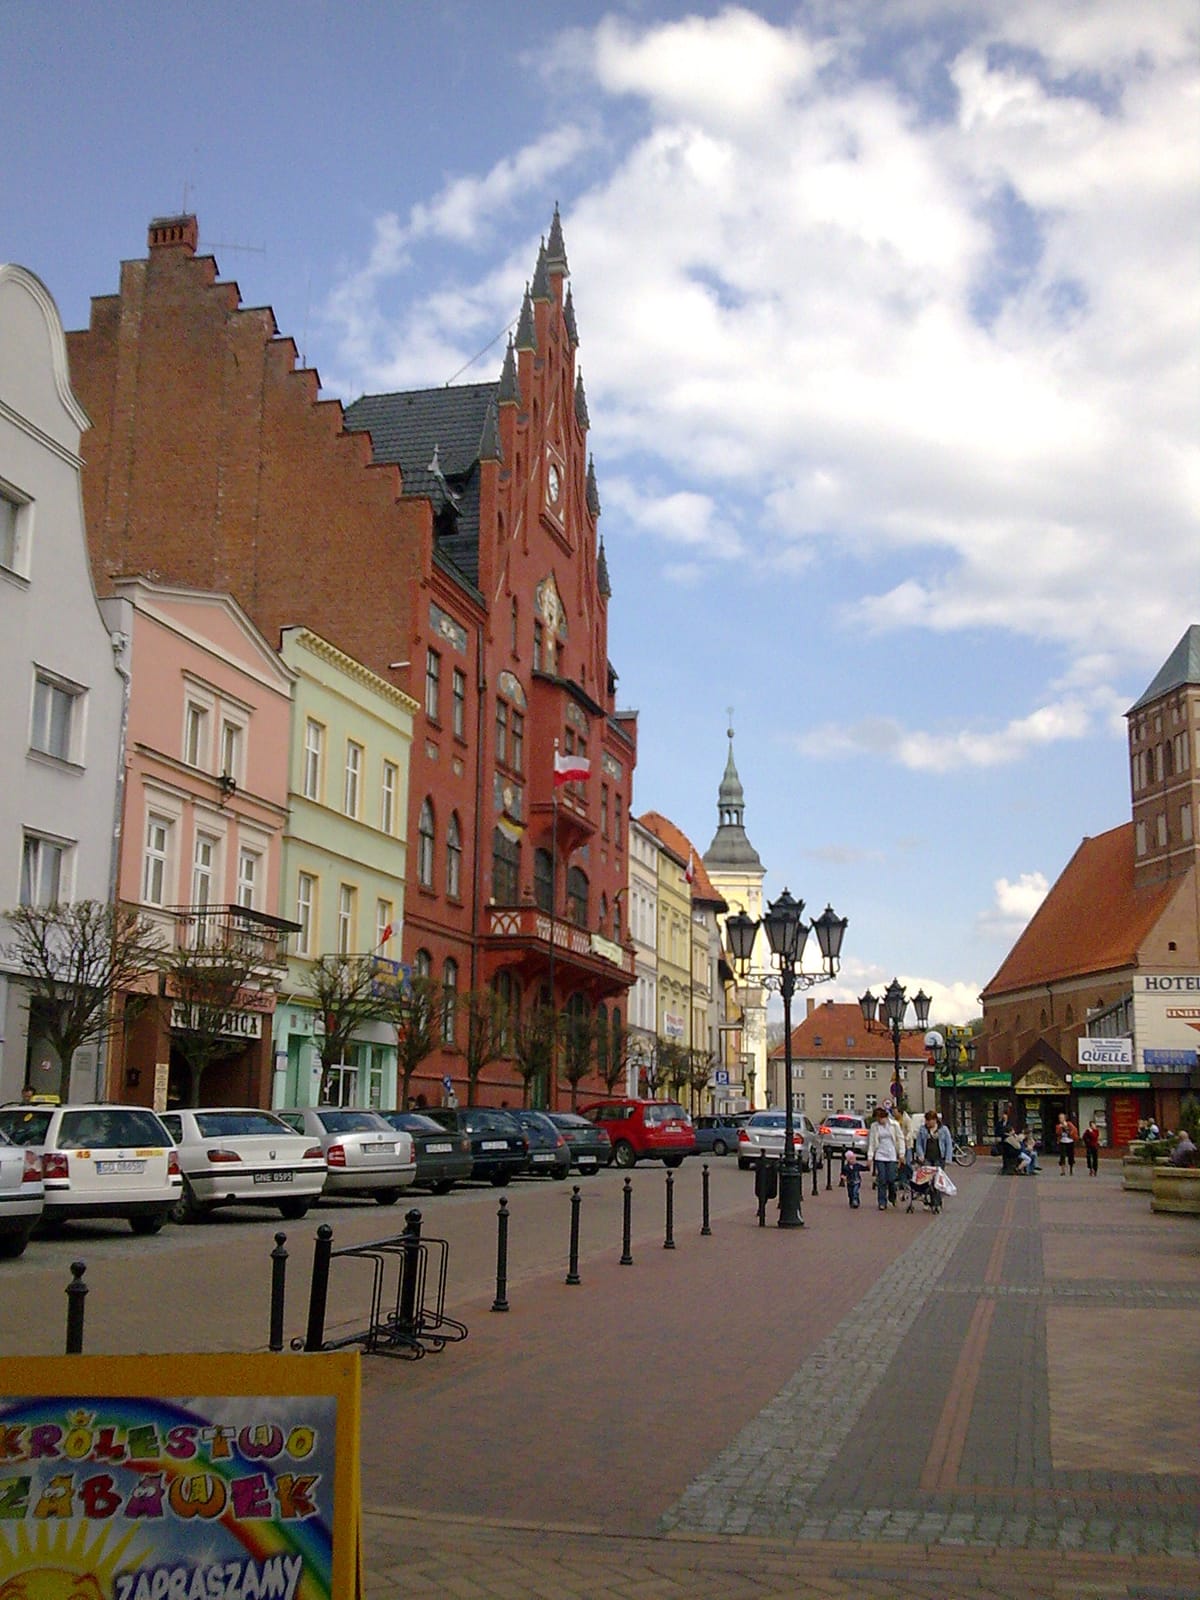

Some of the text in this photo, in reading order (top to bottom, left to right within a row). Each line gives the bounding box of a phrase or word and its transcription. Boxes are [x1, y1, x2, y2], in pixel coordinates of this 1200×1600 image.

[1081, 1050, 1129, 1062] QUELLE
[0, 1473, 319, 1519] ZABAWEK
[116, 1555, 302, 1600] ZAPRASZAMY
